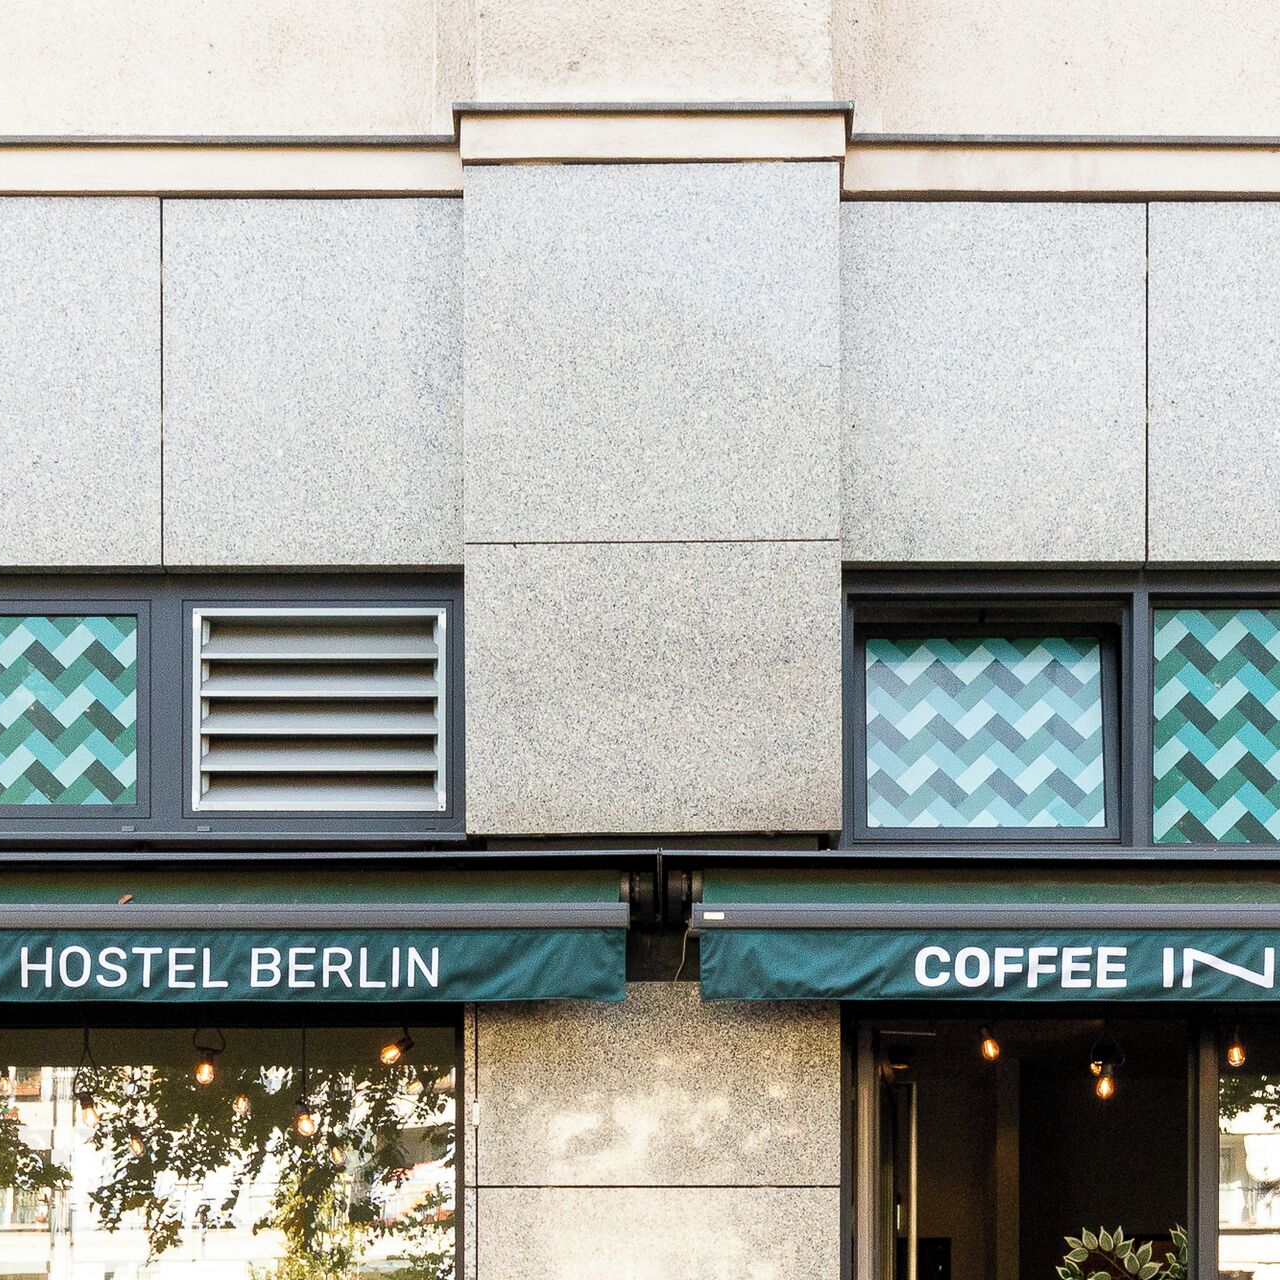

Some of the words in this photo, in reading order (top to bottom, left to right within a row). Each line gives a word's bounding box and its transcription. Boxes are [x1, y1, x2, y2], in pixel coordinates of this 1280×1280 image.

[20, 945, 229, 988] HOSTEL
[250, 946, 439, 988] BERLIN
[914, 946, 1127, 988] COFFEE
